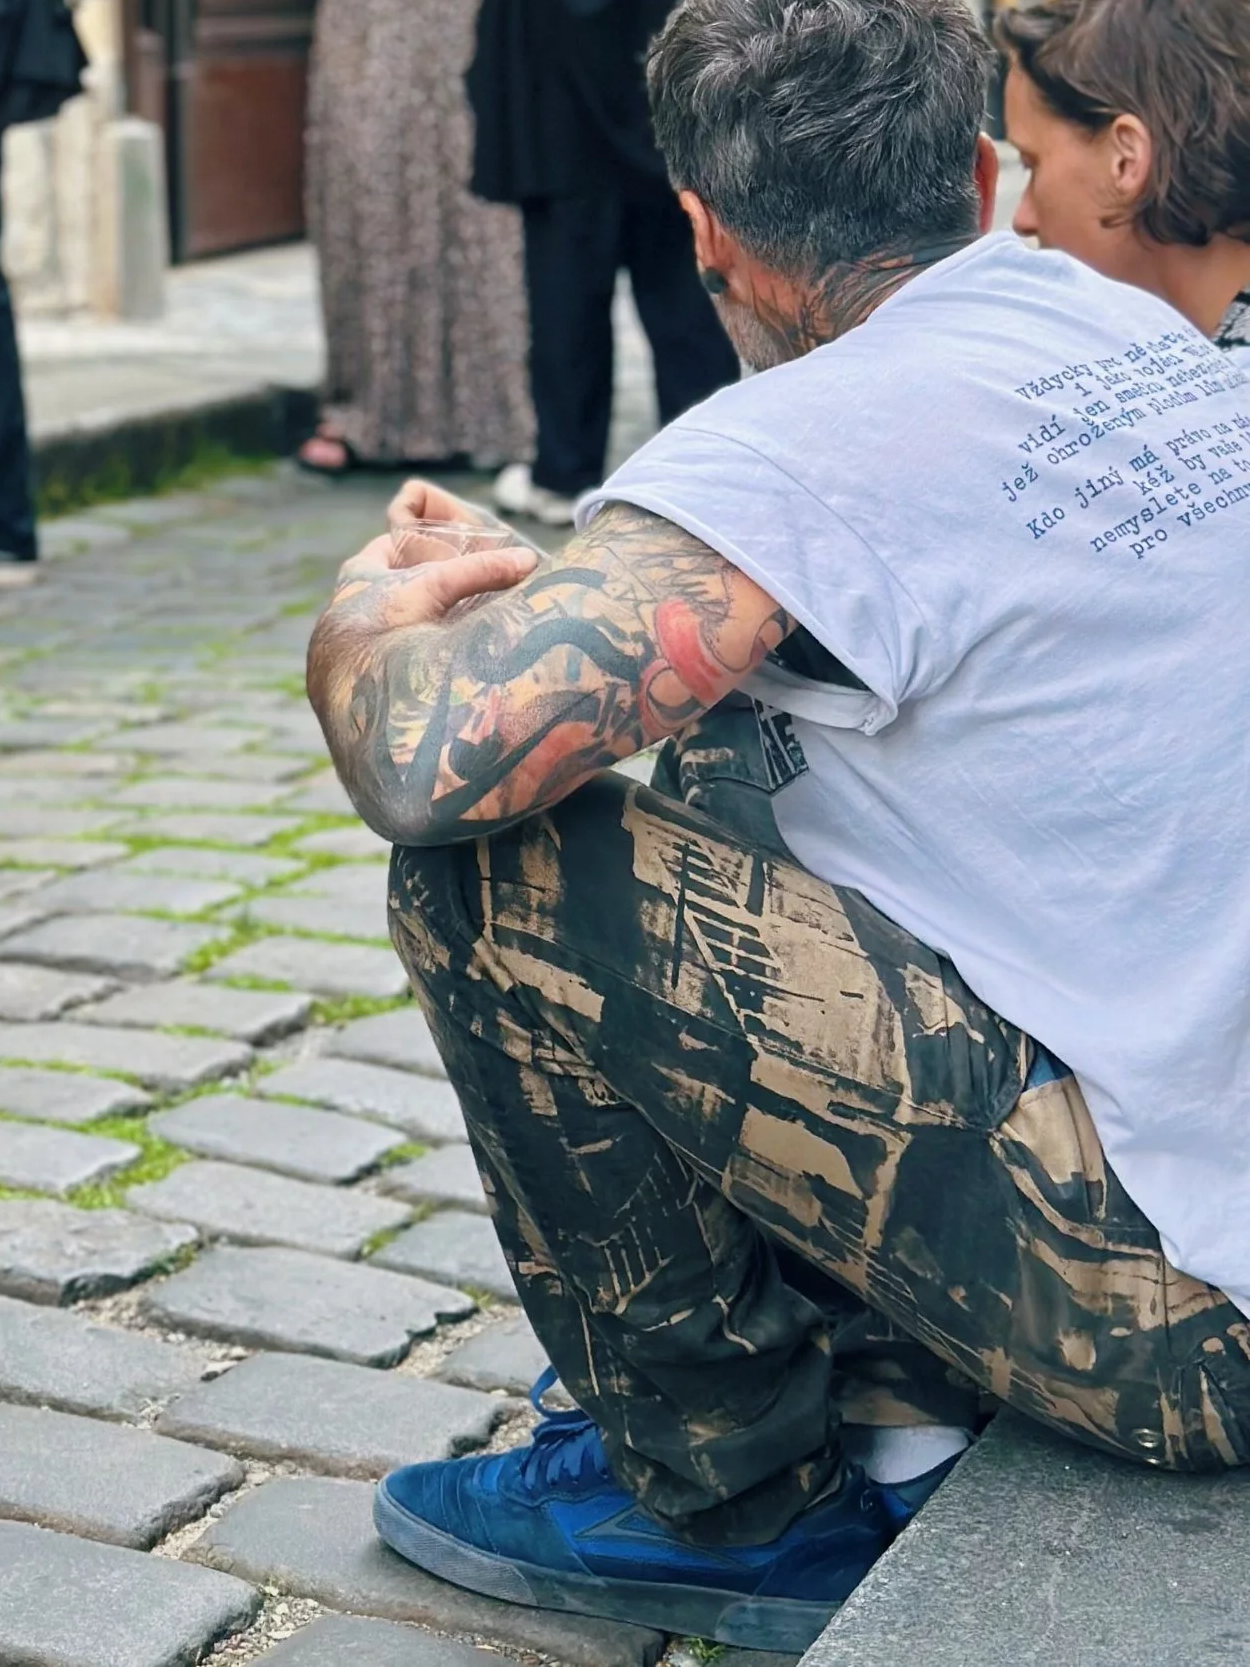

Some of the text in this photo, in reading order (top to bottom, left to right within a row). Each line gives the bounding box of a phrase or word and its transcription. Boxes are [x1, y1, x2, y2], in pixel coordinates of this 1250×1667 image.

[1014, 363, 1094, 400] Vždycky
[1018, 414, 1066, 453] vidí
[1072, 399, 1111, 423] jen
[1002, 461, 1039, 502] jež
[1047, 407, 1147, 465] ohroženým
[1132, 464, 1175, 495] kéž
[1178, 454, 1206, 471] by
[1026, 507, 1065, 539] Kdo
[1075, 466, 1124, 509] jiný
[1129, 444, 1160, 472] má
[1165, 428, 1212, 456] právo
[1090, 482, 1202, 553] nemyslete
[1208, 467, 1233, 485] na
[1129, 529, 1169, 559] pro
